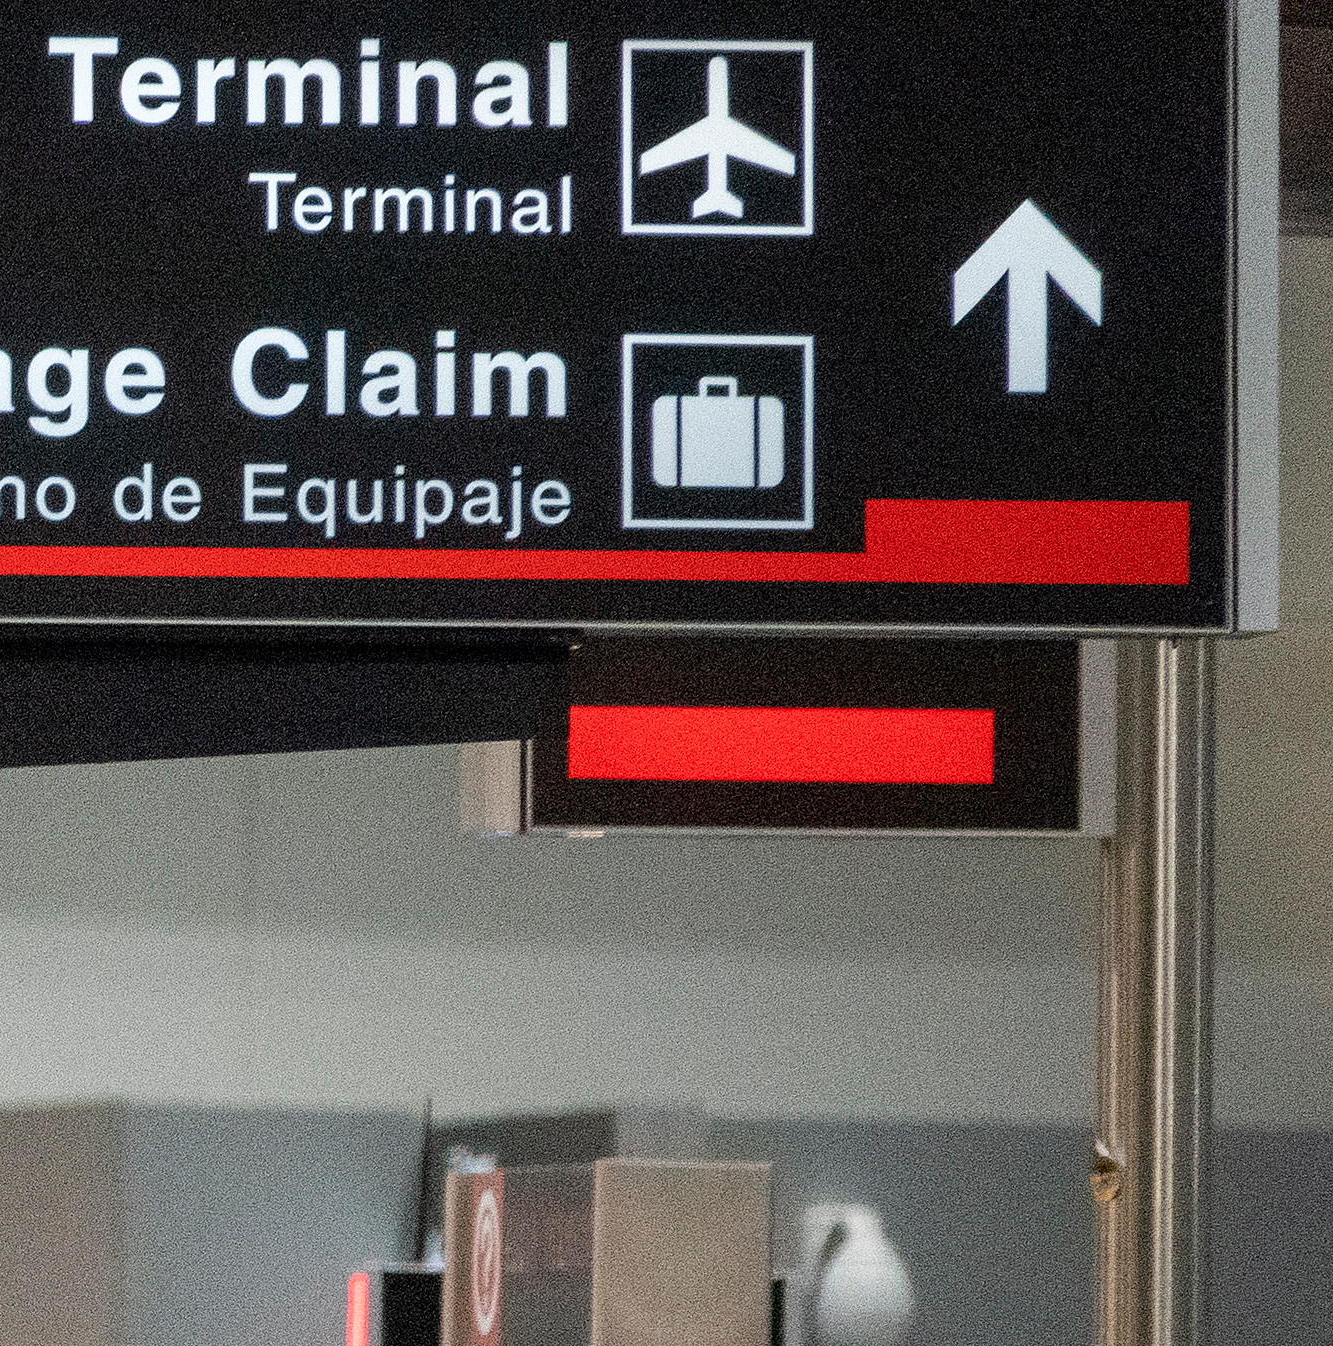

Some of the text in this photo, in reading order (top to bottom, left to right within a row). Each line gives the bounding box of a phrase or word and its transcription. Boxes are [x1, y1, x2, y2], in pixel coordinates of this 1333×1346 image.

[46, 35, 569, 129] Terminal
[247, 171, 573, 236] Terminal
[229, 326, 568, 419] Claim
[112, 461, 203, 522] de
[242, 463, 572, 540] Equipaje
